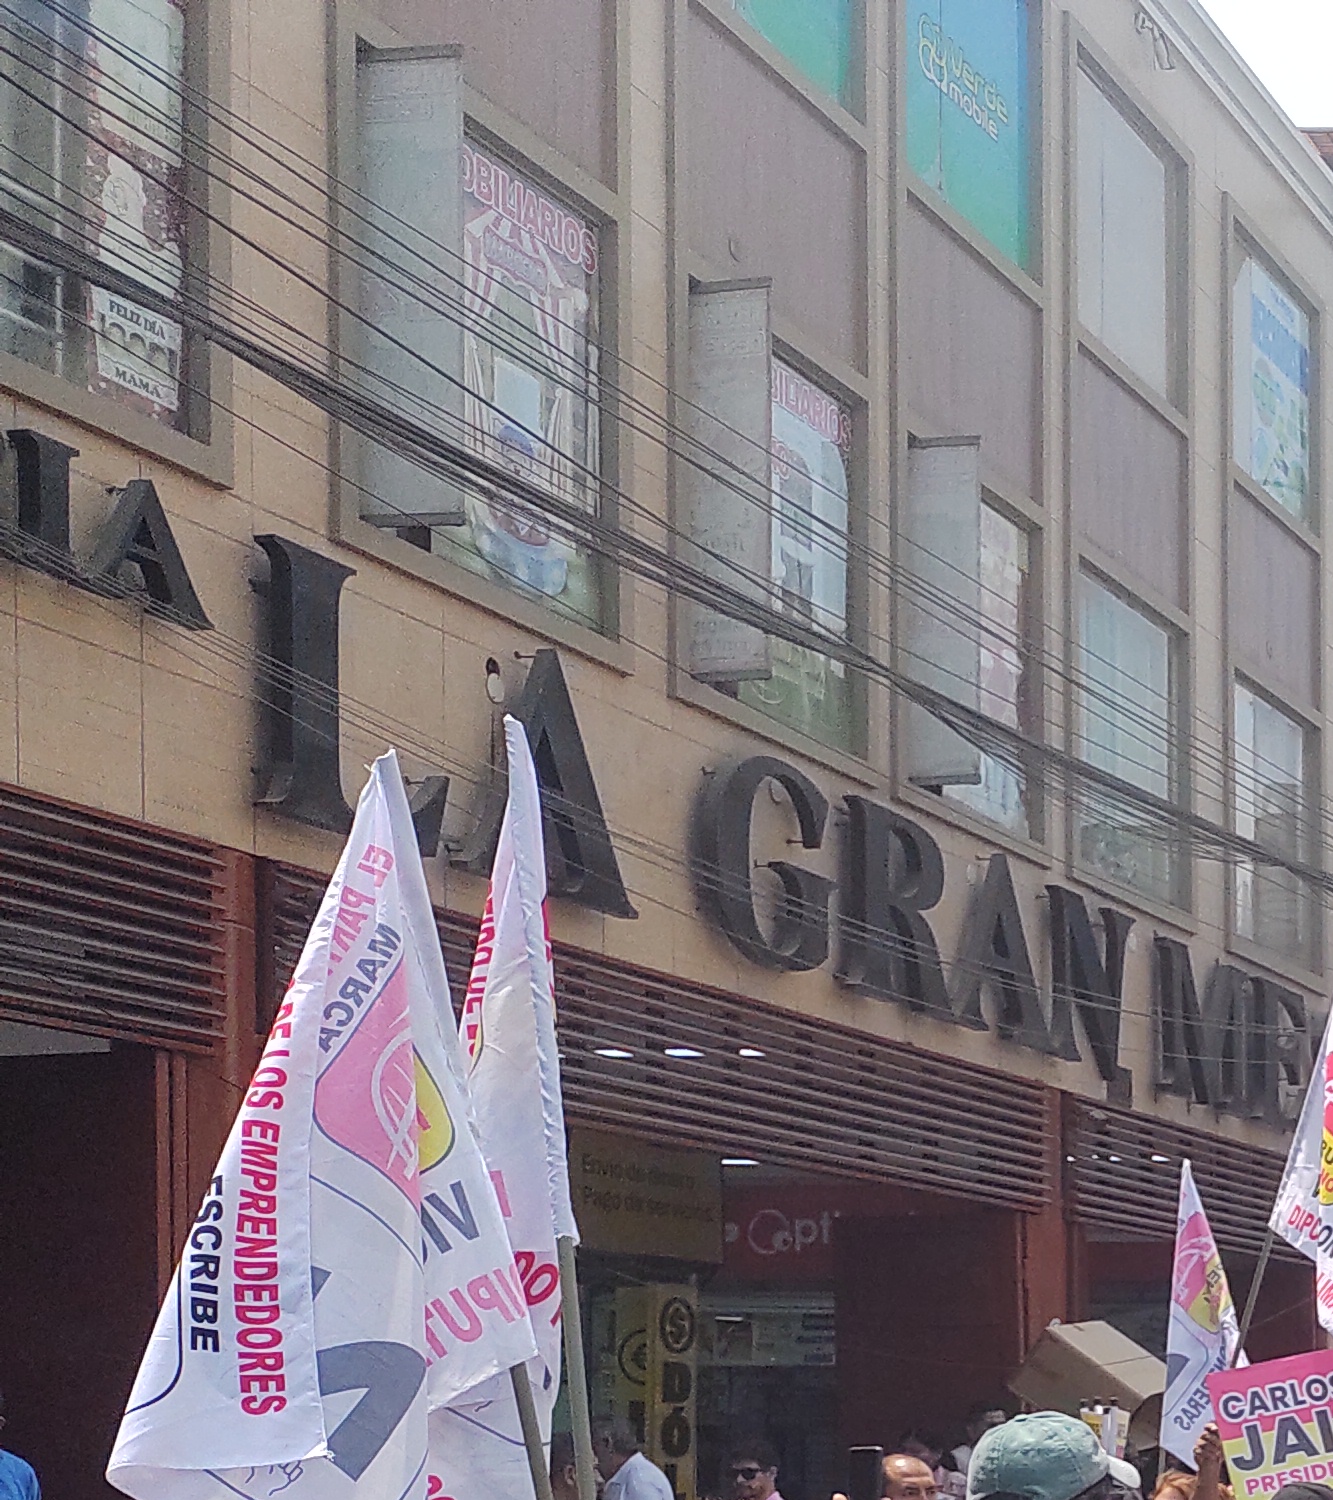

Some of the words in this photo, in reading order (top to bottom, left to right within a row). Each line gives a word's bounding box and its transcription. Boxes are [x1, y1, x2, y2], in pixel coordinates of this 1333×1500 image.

[949, 81, 998, 142] mobile
[463, 143, 598, 274] OBILIARIOS
[108, 298, 142, 326] FELIZ
[690, 754, 1137, 1101] GRAN
[188, 1174, 224, 1354] ESCRIBE
[232, 1119, 288, 1417] EMPRENDEDORES
